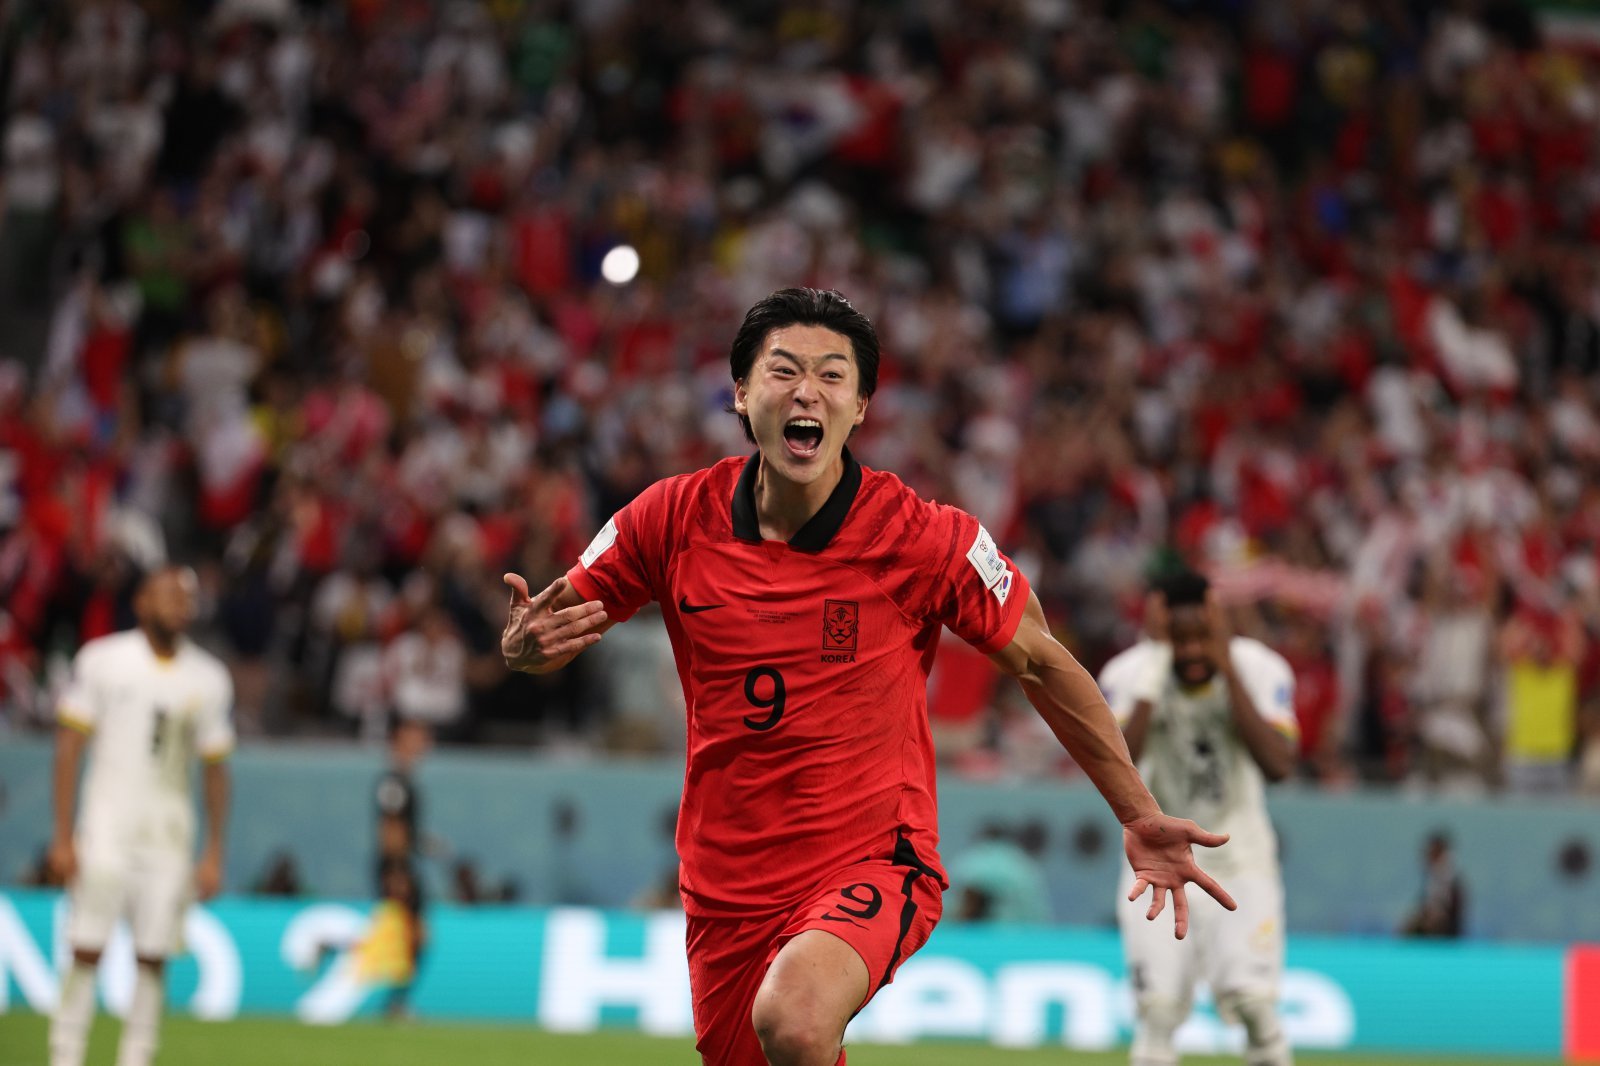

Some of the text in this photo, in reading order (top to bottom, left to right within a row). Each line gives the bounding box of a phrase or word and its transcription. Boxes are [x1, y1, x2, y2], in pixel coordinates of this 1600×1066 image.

[820, 654, 856, 664] KOREA
[743, 666, 786, 732] 9
[835, 883, 883, 919] 9
